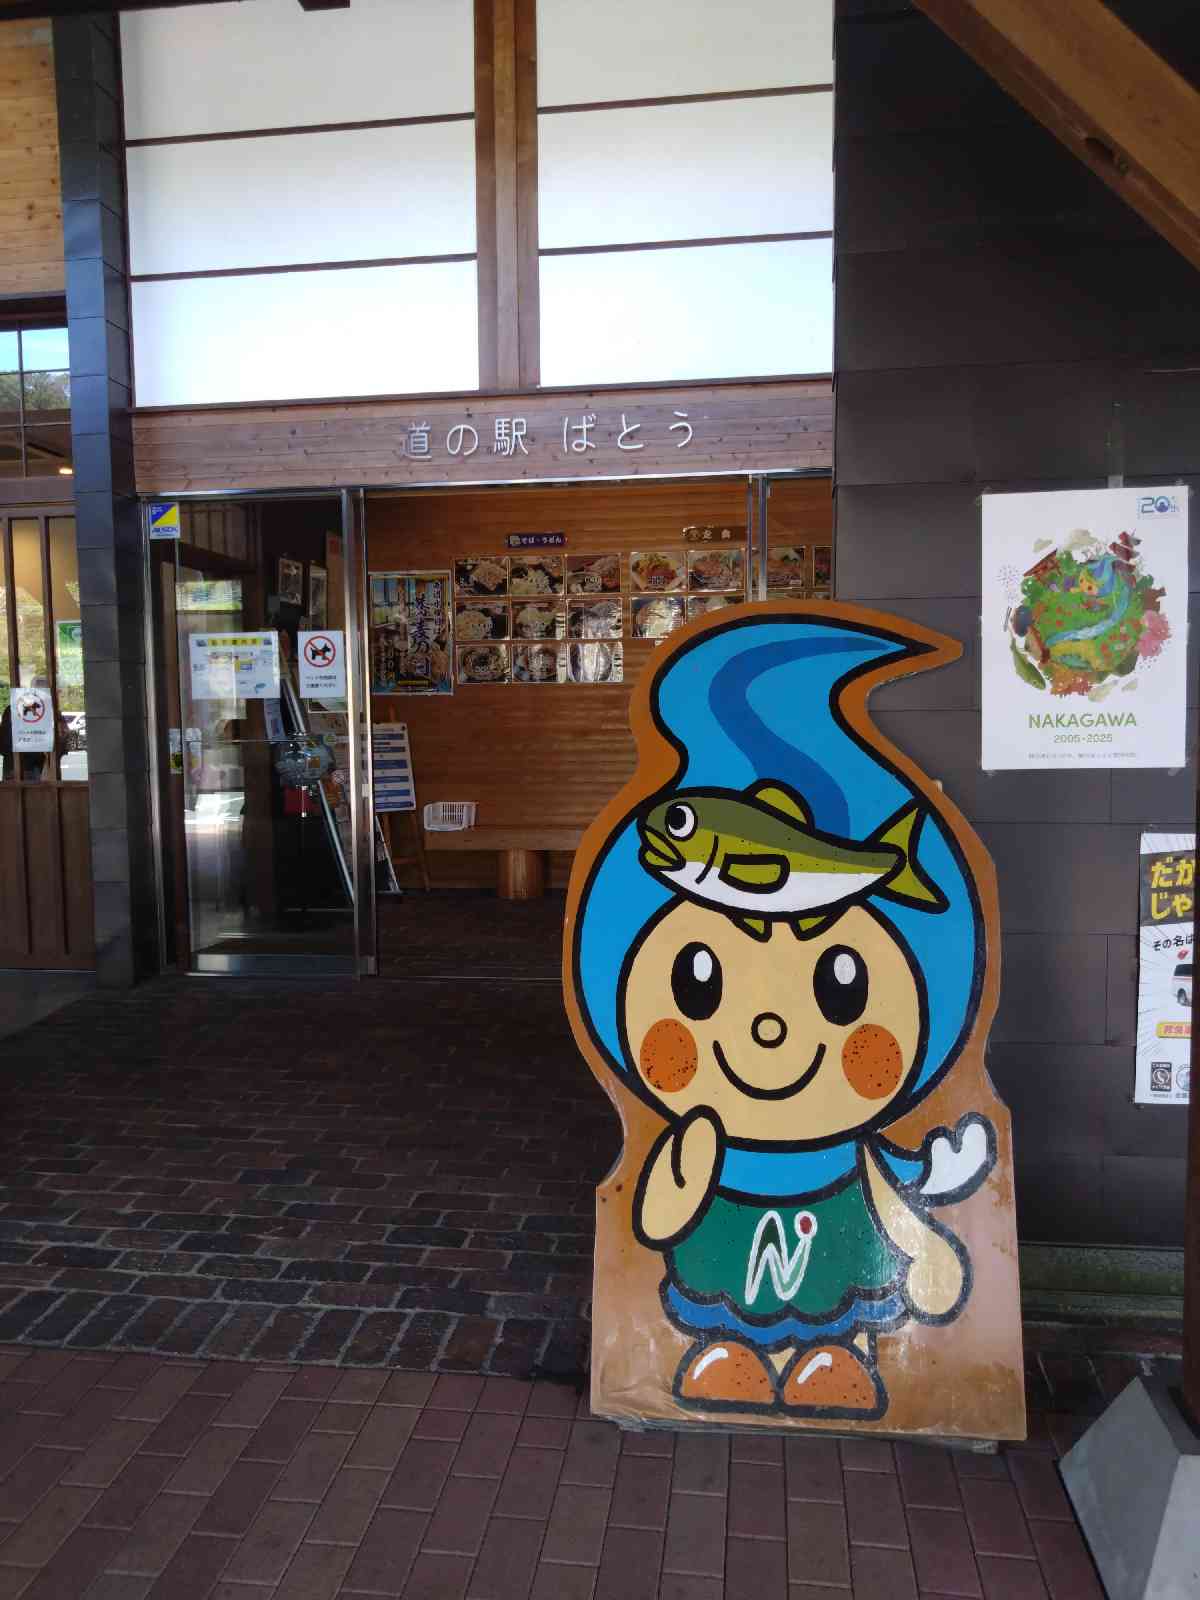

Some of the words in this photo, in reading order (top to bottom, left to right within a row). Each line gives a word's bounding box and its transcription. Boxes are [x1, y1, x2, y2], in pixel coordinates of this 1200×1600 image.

[401, 417, 529, 458] 道の駅
[561, 411, 693, 453] ばとう
[1028, 712, 1137, 729] NAKAGAWA
